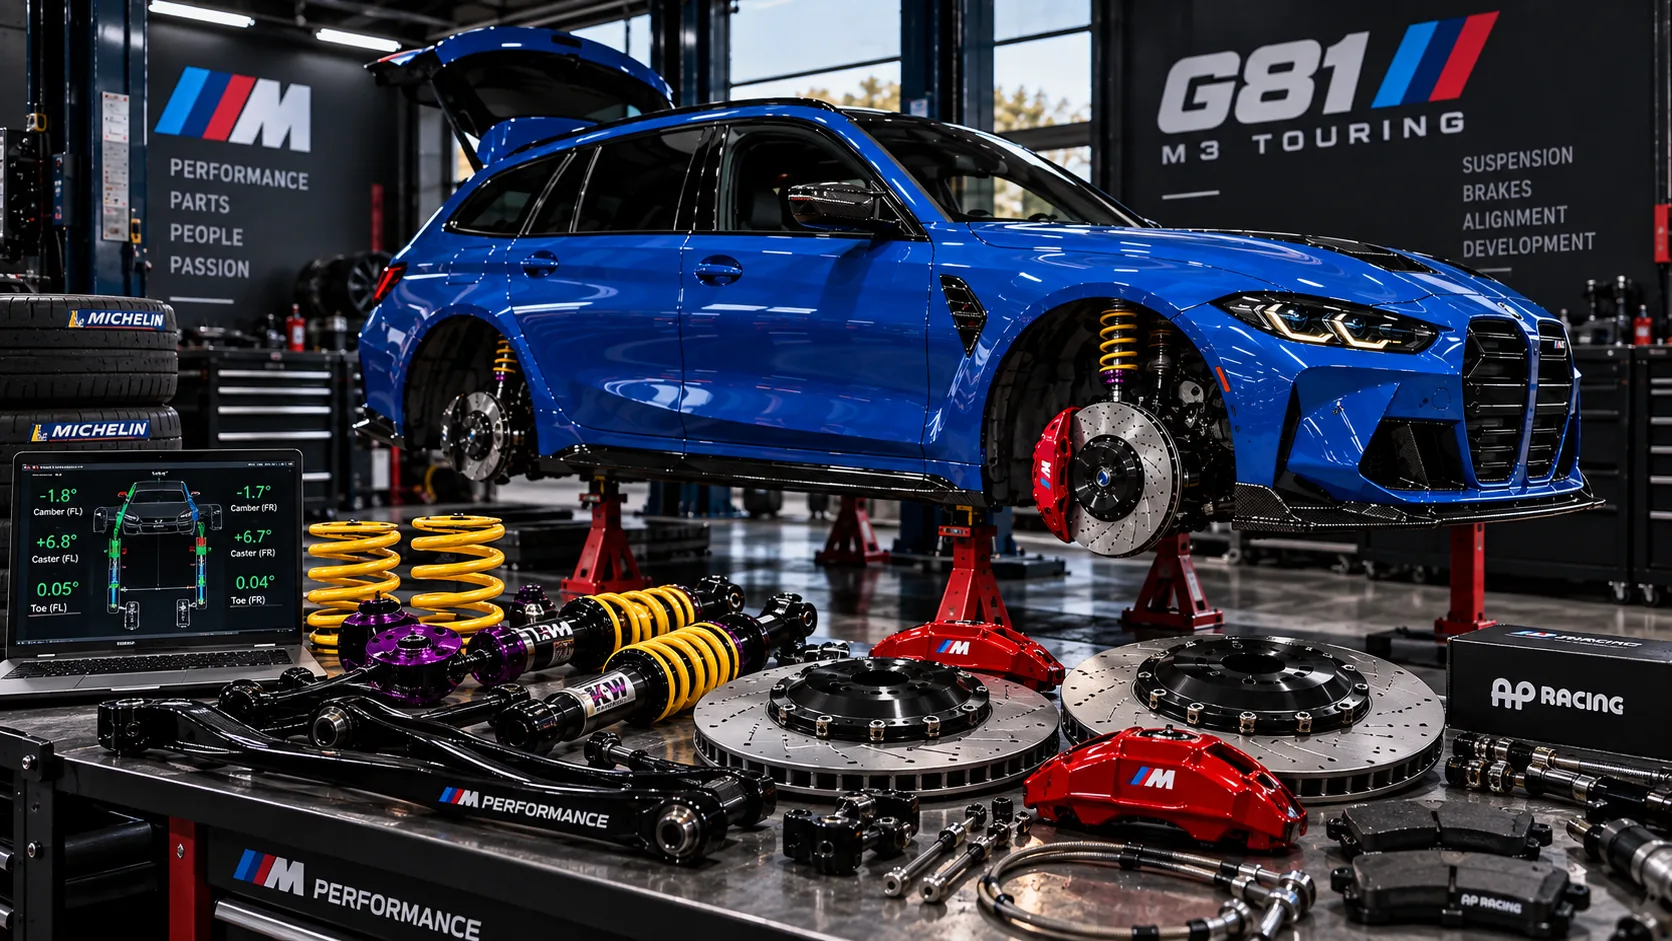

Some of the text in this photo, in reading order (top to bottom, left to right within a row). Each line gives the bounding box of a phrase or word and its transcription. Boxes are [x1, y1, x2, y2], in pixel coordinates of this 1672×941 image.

[1157, 31, 1370, 135] G81
[1252, 111, 1465, 155] TOURING
[1462, 145, 1574, 175] SUSPENSION
[170, 158, 309, 191] PERFORMANCE
[1462, 179, 1533, 203] BRAKES
[170, 191, 230, 214] PARTS
[1462, 205, 1569, 231] ALIGNMENT
[170, 223, 244, 247] PEOPLE
[1462, 231, 1597, 258] DEVELOPMENT
[170, 255, 250, 279] PASSION
[87, 311, 165, 328] MICHELIN
[51, 422, 148, 438] MICHELIN
[39, 488, 77, 503] -1.8°
[236, 485, 272, 499] -1.7°
[33, 506, 83, 517] Camber (FL)
[230, 502, 278, 514] Camber (FR)
[36, 533, 77, 549] +6.8°
[234, 529, 272, 544] +6.7°
[31, 553, 79, 565] Caster (FL)
[230, 548, 276, 559] Caster (FR)
[36, 581, 79, 597] 0.05°
[235, 575, 275, 590] 0.04°
[30, 602, 68, 614] Toe (FL)
[230, 595, 266, 606] Toe (FR)
[1490, 677, 1625, 716] AP RACING
[481, 795, 610, 830] PERFORMANCE
[312, 878, 482, 941] PERFORMANCE
[1460, 893, 1523, 915] AP RACING
